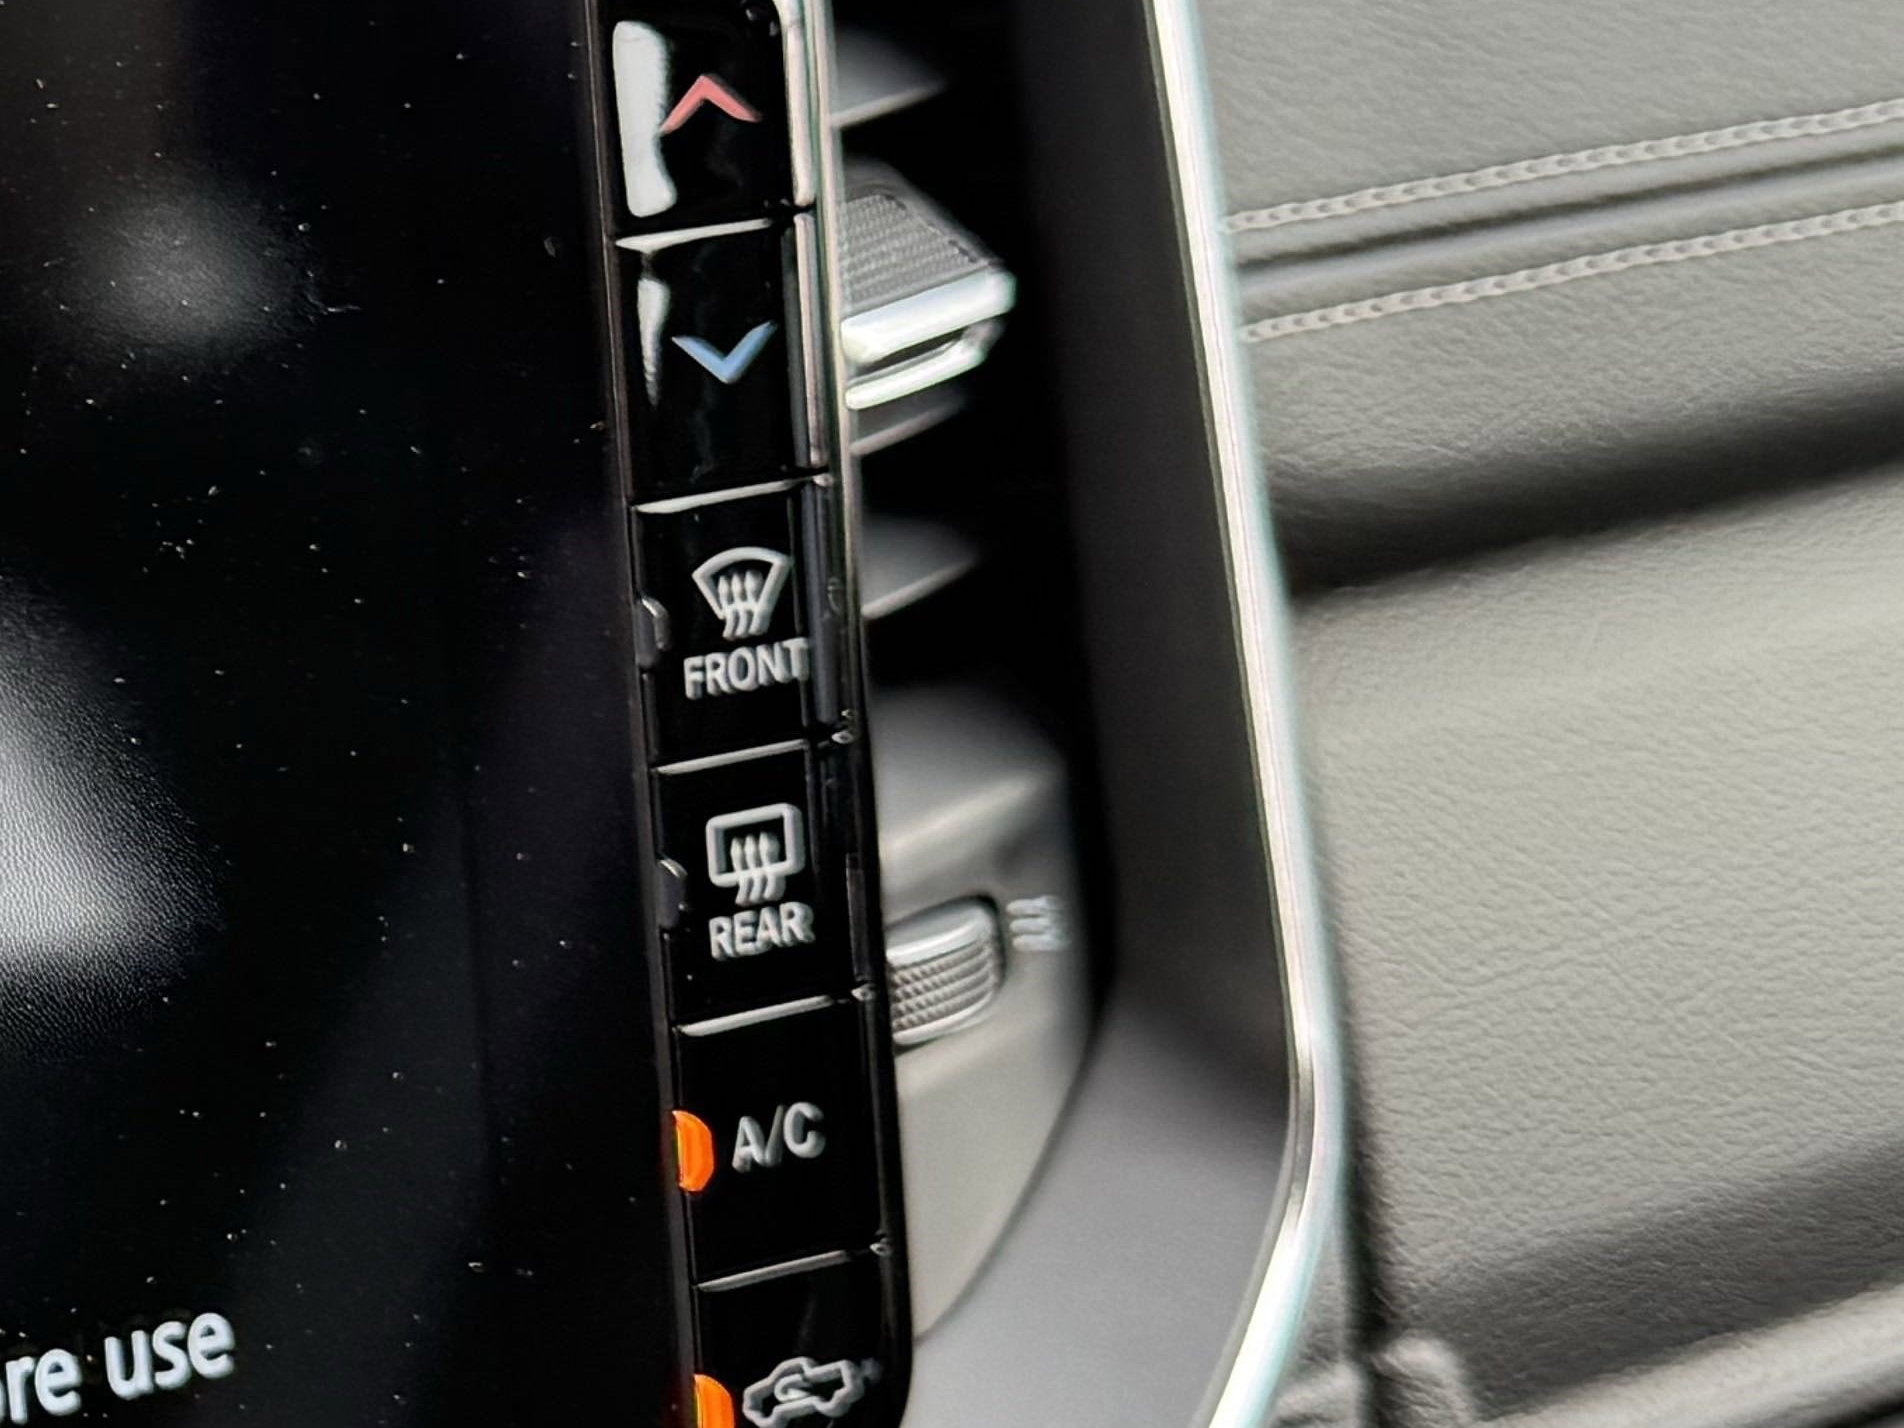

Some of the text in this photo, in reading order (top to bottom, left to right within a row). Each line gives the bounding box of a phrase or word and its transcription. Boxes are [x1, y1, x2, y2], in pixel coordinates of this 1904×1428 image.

[683, 636, 811, 700] FRONT
[708, 901, 816, 960] REAR
[731, 1101, 826, 1172] A/C
[103, 1311, 235, 1399] use
